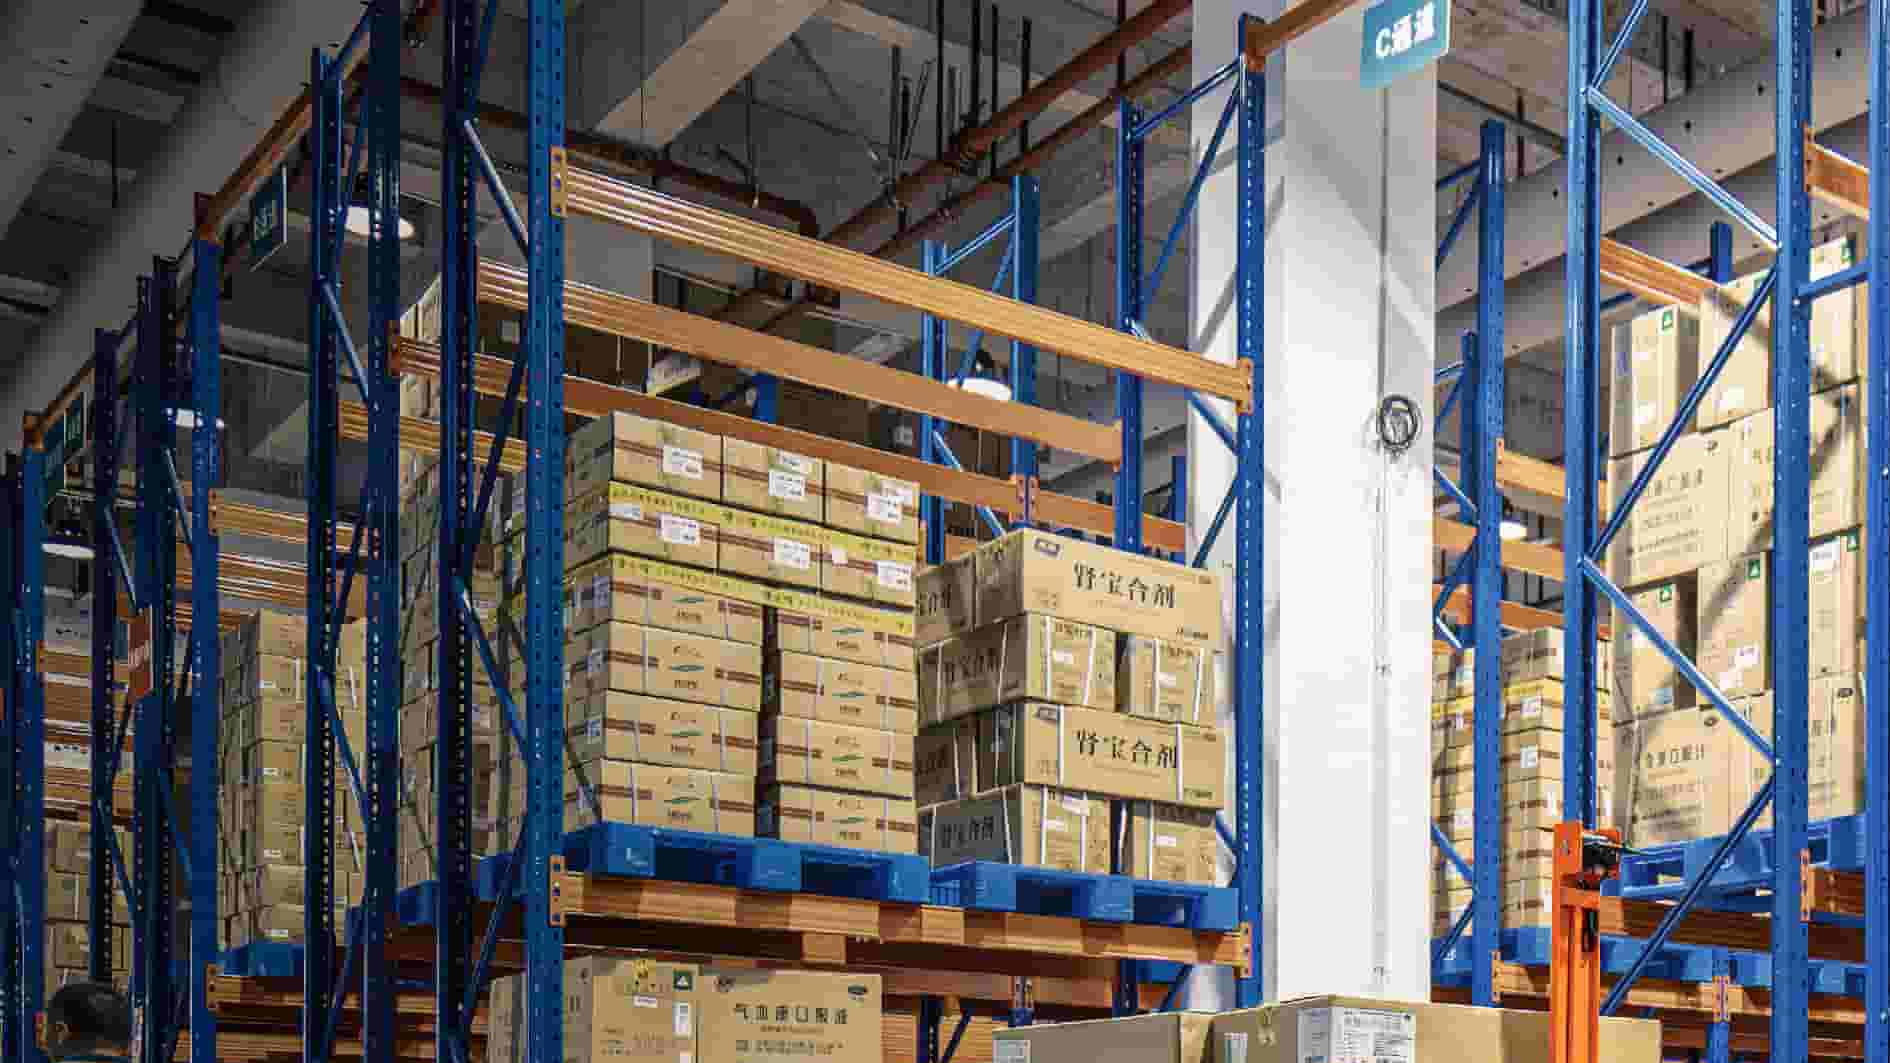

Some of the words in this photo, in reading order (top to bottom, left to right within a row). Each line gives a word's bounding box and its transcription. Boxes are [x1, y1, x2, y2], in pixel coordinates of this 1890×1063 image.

[1375, 1, 1435, 57] C通道
[1073, 561, 1175, 609] 肾宝合剂
[1076, 729, 1177, 768] 肾宝合剂
[733, 1002, 848, 1025] 气血康口服液
